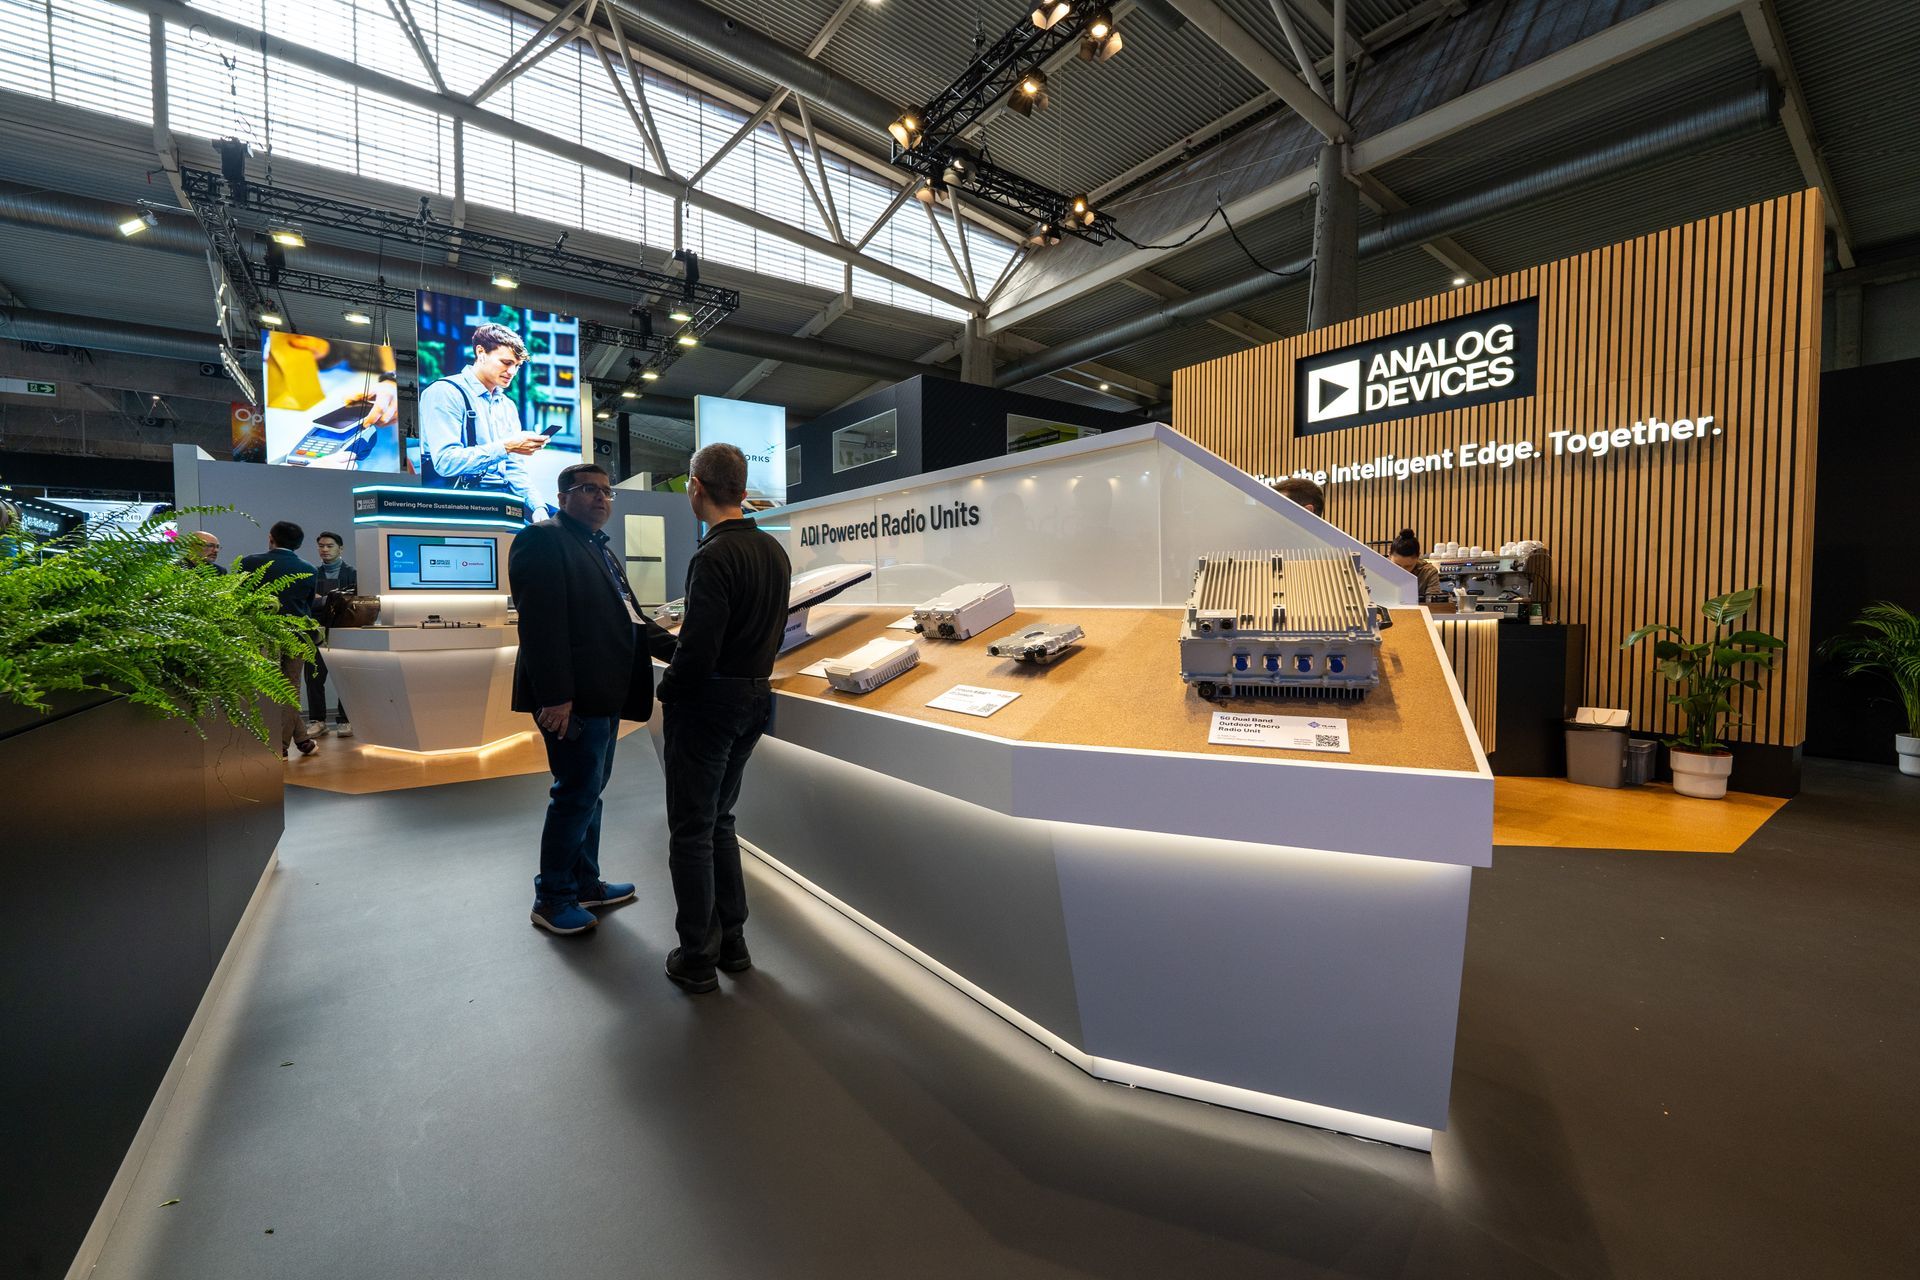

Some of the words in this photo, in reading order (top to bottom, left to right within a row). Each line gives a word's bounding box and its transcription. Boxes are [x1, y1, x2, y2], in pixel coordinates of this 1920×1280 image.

[1367, 323, 1514, 382] ANALOG
[1365, 356, 1515, 412] DEVICES
[235, 408, 264, 426] Op
[1331, 448, 1454, 484] Intelligent
[1459, 440, 1541, 468] Edge.
[1548, 415, 1722, 457] Together.
[383, 500, 416, 509] Delivering
[800, 525, 820, 547] ADI
[821, 515, 878, 545] Powered
[881, 508, 926, 537] Radio
[930, 500, 980, 531] Units
